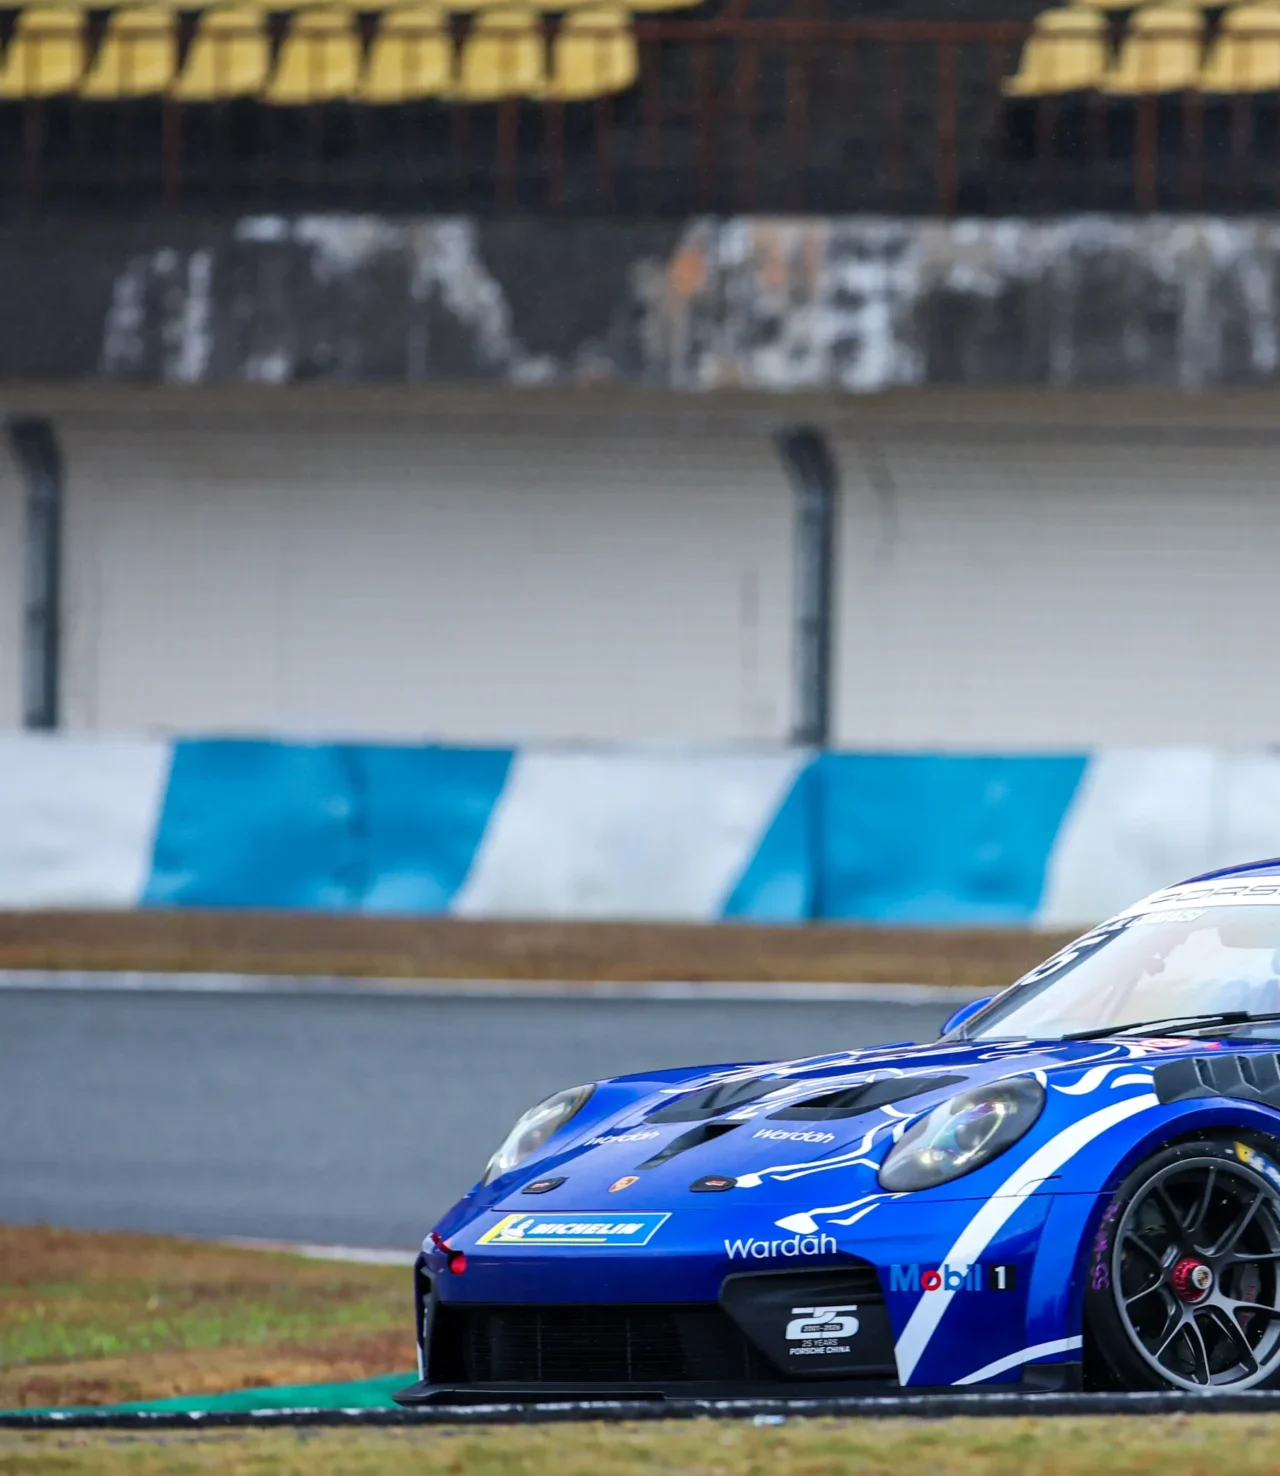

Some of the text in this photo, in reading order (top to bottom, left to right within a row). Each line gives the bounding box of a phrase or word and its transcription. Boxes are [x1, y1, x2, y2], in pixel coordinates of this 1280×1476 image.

[527, 1223, 646, 1235] MICHELIN
[890, 1263, 1006, 1292] Mobil 1
[802, 1339, 838, 1348] 25 YEARS
[789, 1345, 851, 1355] PORSCHE CHINA
